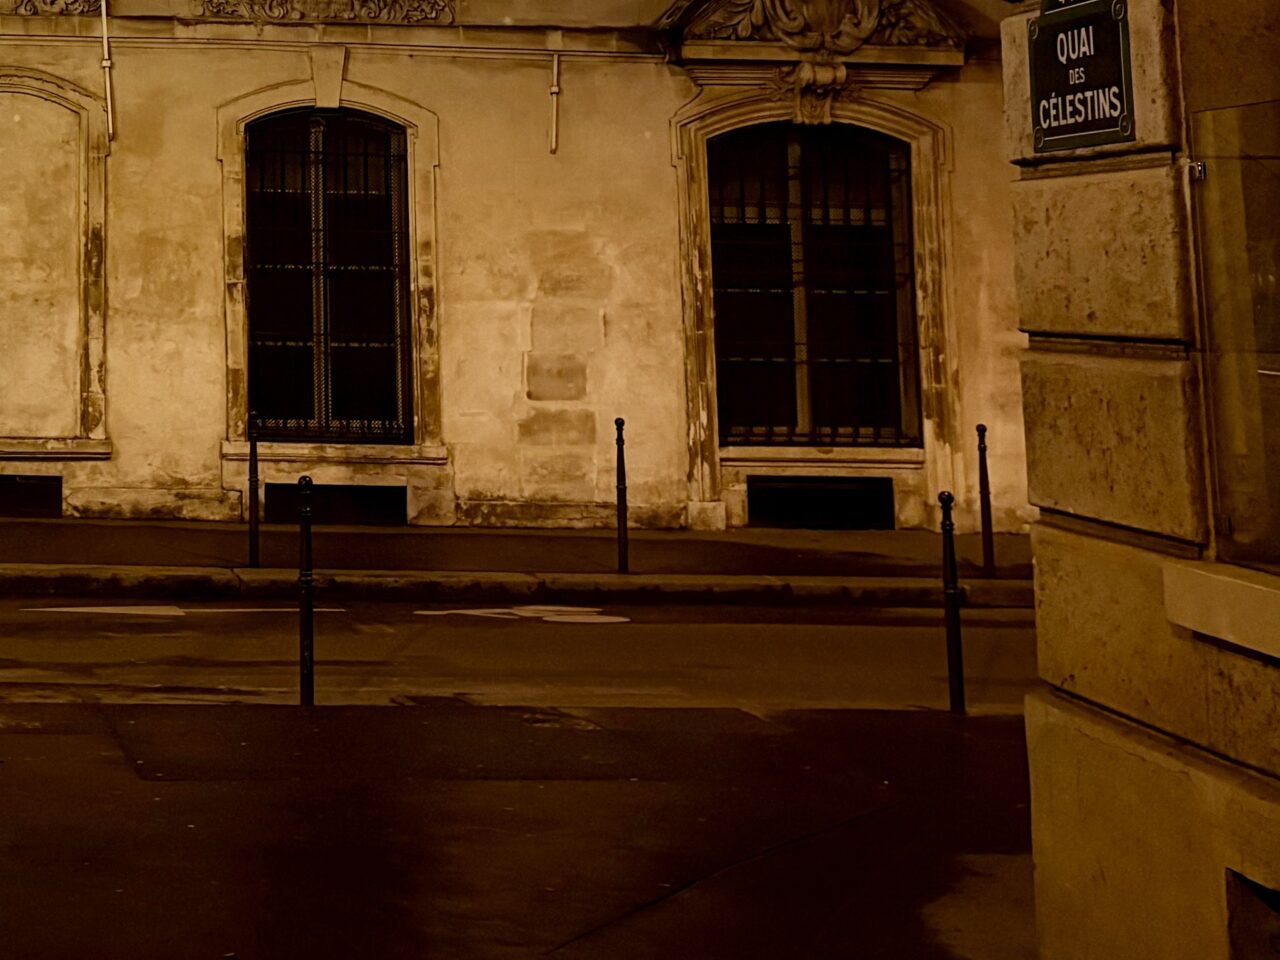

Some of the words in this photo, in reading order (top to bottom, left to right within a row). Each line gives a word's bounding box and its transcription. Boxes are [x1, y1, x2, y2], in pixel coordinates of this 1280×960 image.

[1056, 25, 1095, 65] QUAI
[1069, 67, 1086, 85] DES
[1039, 86, 1121, 129] CÉLESTINS
